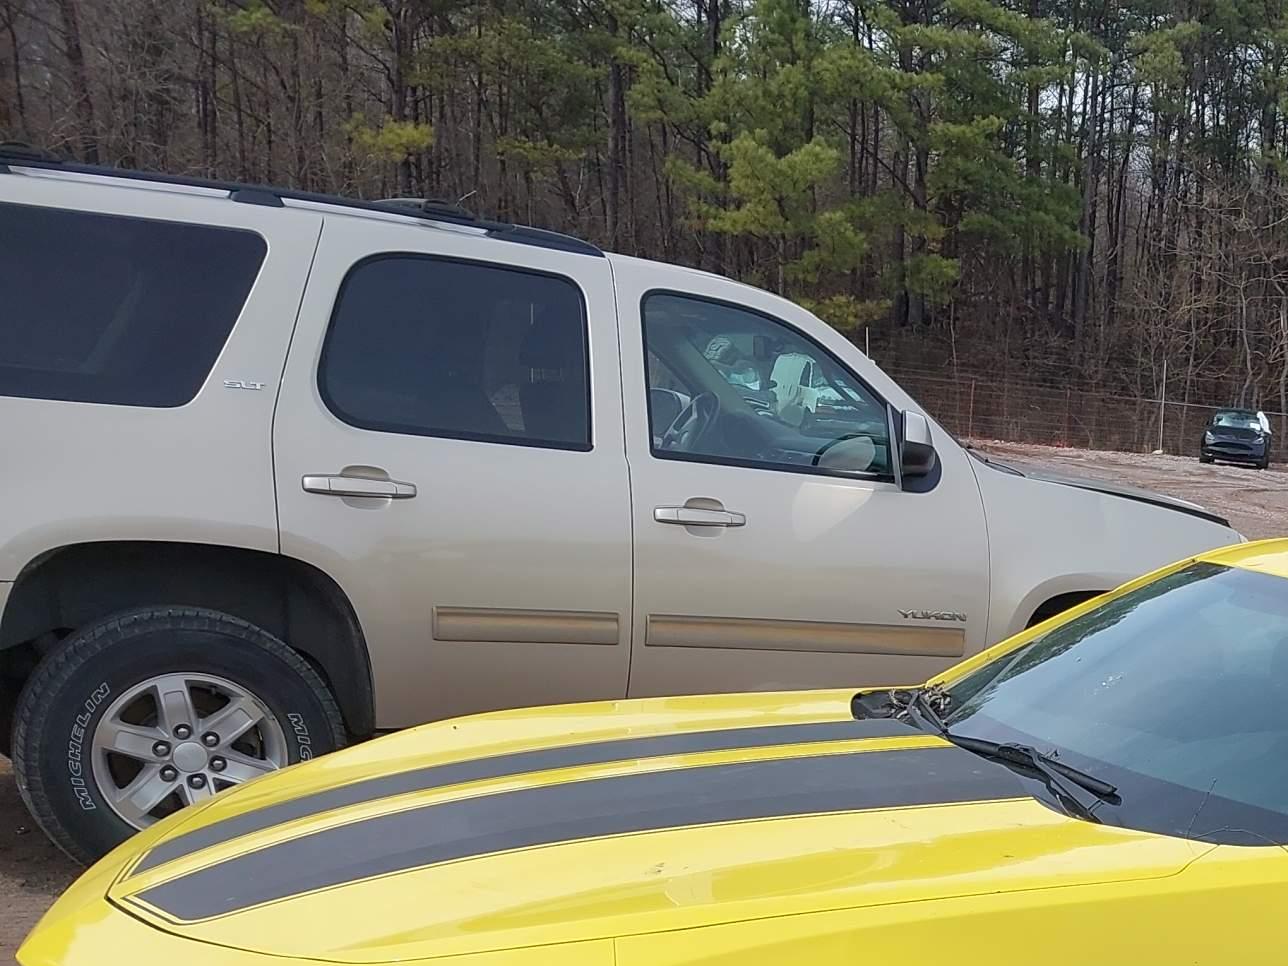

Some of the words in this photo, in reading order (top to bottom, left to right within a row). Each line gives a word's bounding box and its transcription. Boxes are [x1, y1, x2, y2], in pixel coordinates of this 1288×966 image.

[223, 380, 265, 391] SLT
[897, 607, 967, 622] YUKON
[68, 682, 110, 811] MICHELIN
